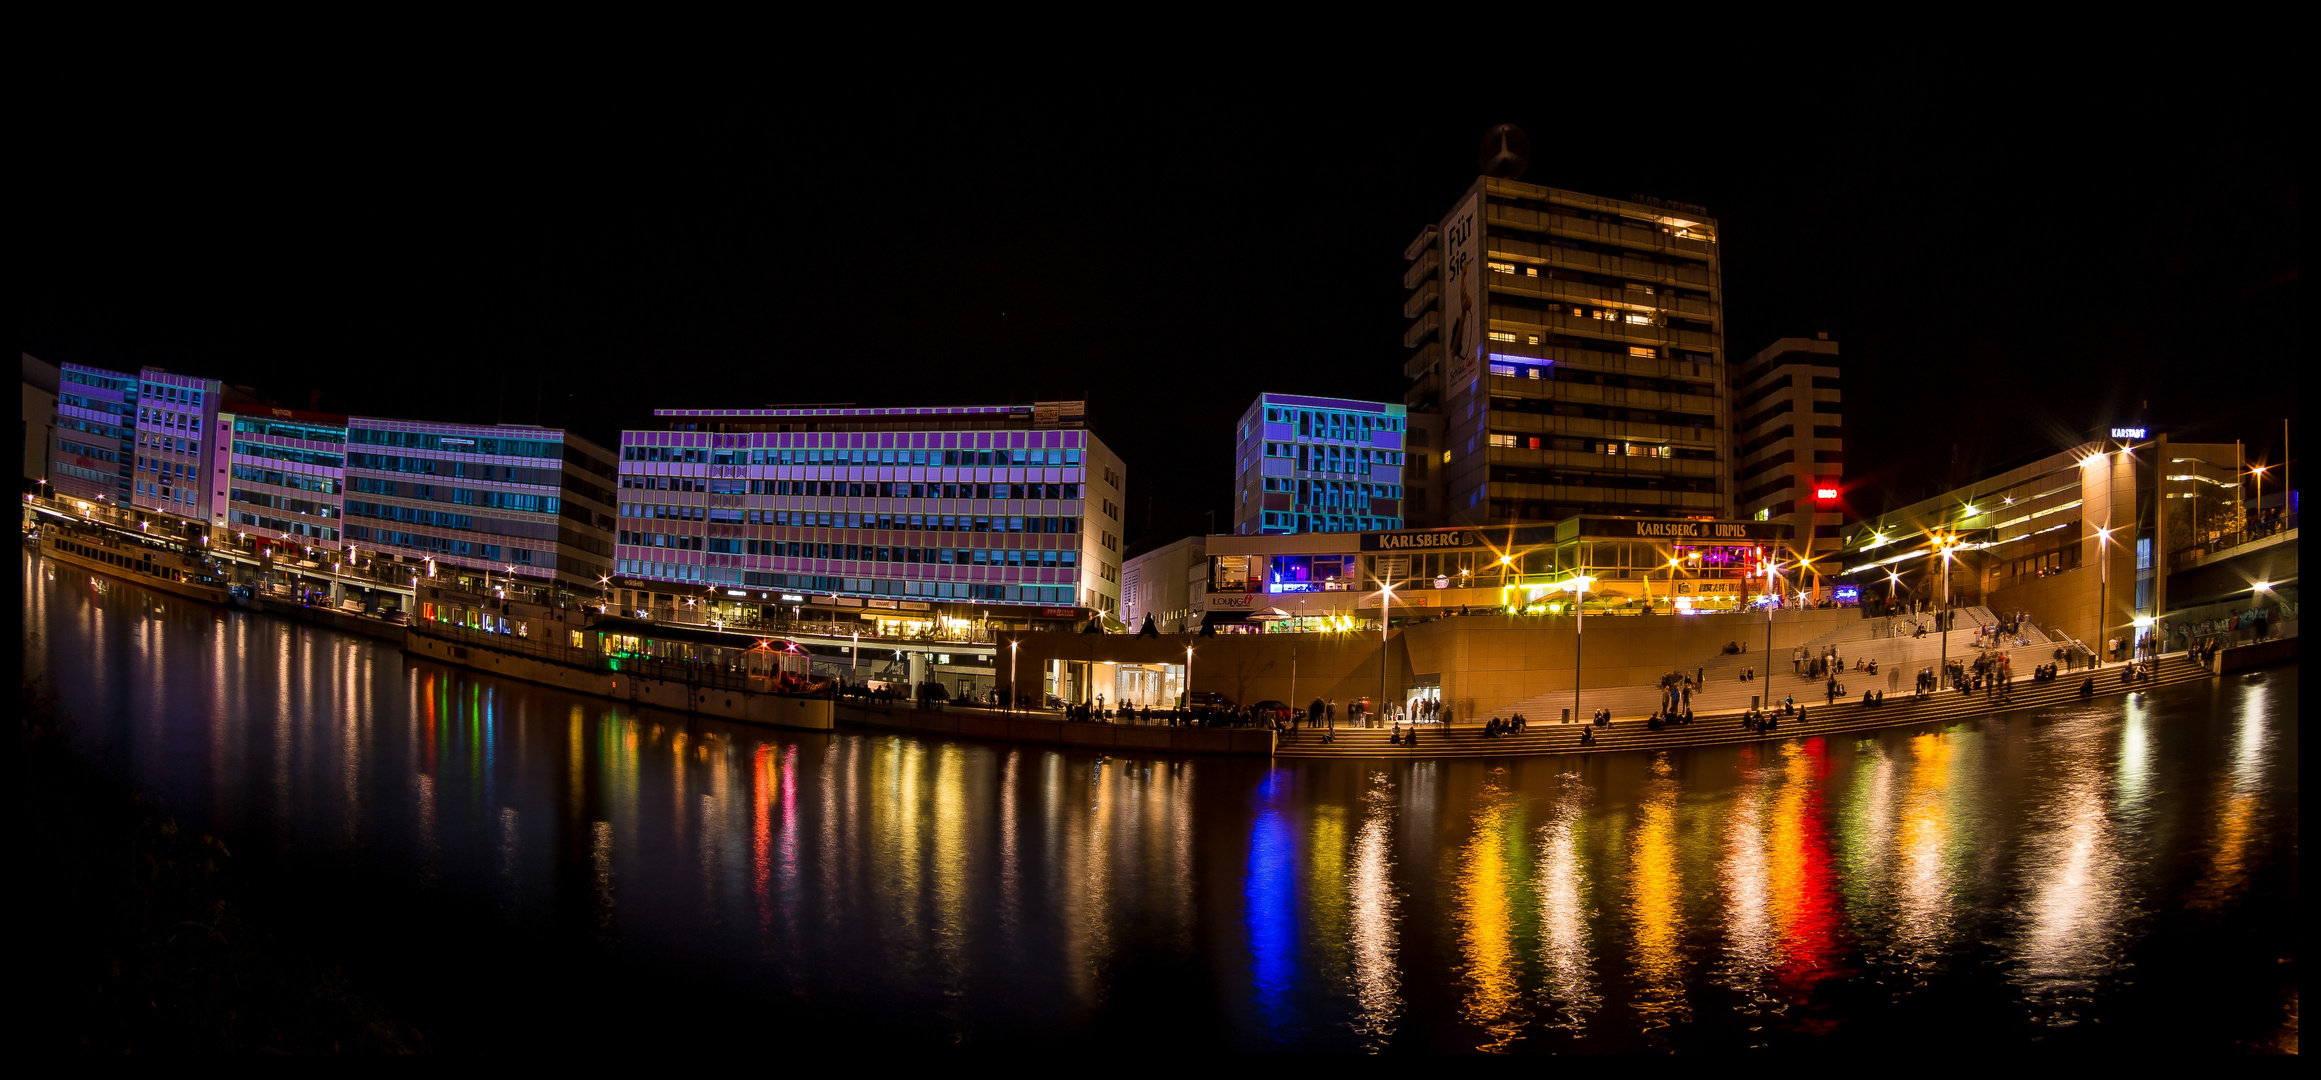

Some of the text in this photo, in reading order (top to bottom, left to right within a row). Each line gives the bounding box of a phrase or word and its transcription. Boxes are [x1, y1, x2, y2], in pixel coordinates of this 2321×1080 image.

[1449, 213, 1473, 256] Für
[2111, 428, 2145, 439] KARSTADT
[1636, 521, 1746, 537] KARLSBERG URPILS
[1379, 531, 1459, 549] KARLSBERG
